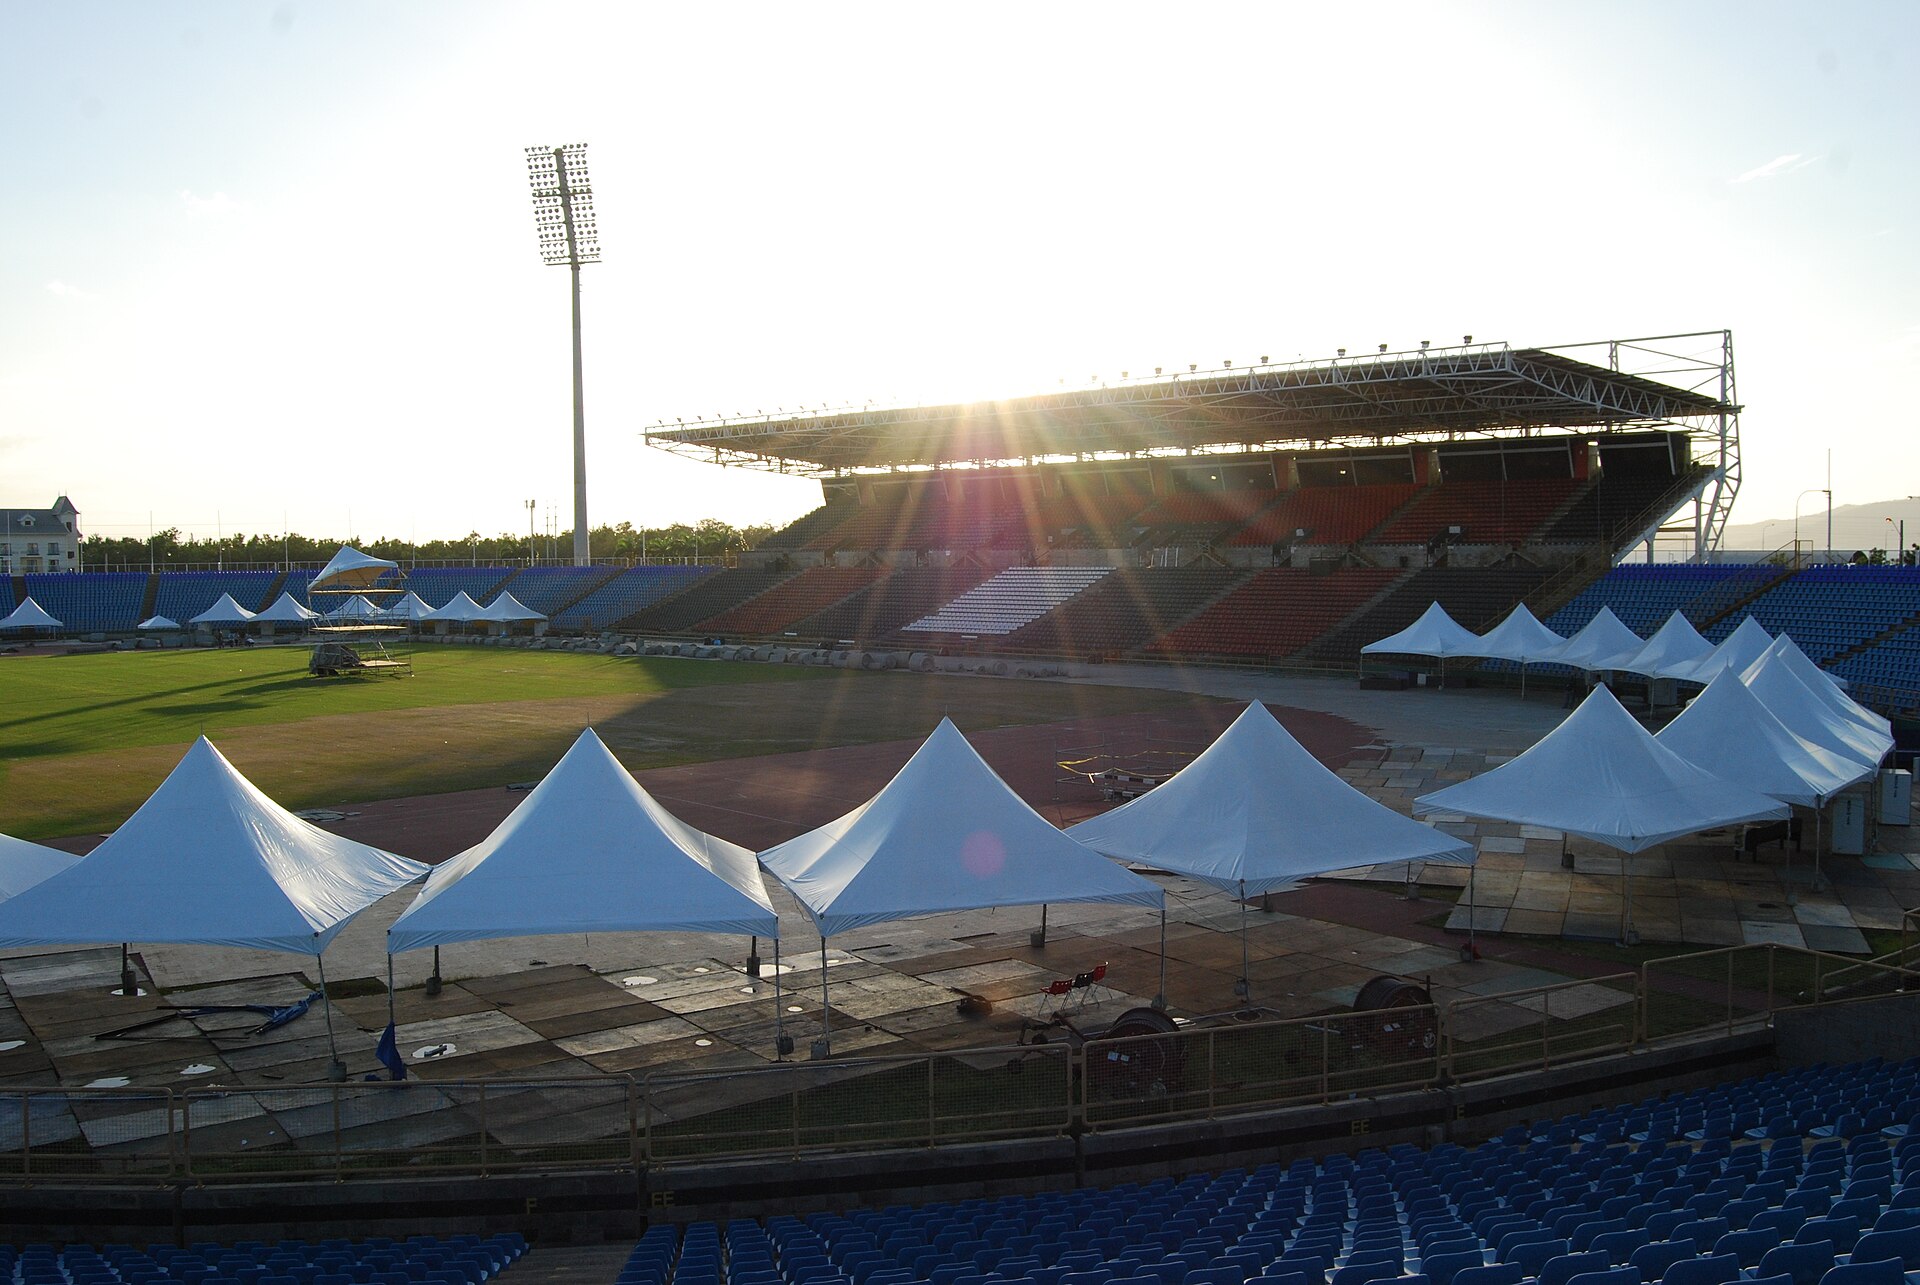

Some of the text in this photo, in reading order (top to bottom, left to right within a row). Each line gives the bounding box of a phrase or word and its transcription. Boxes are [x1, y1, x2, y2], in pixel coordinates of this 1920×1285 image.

[1457, 1104, 1465, 1119] E
[1351, 1118, 1370, 1135] EE
[651, 1190, 675, 1208] EE
